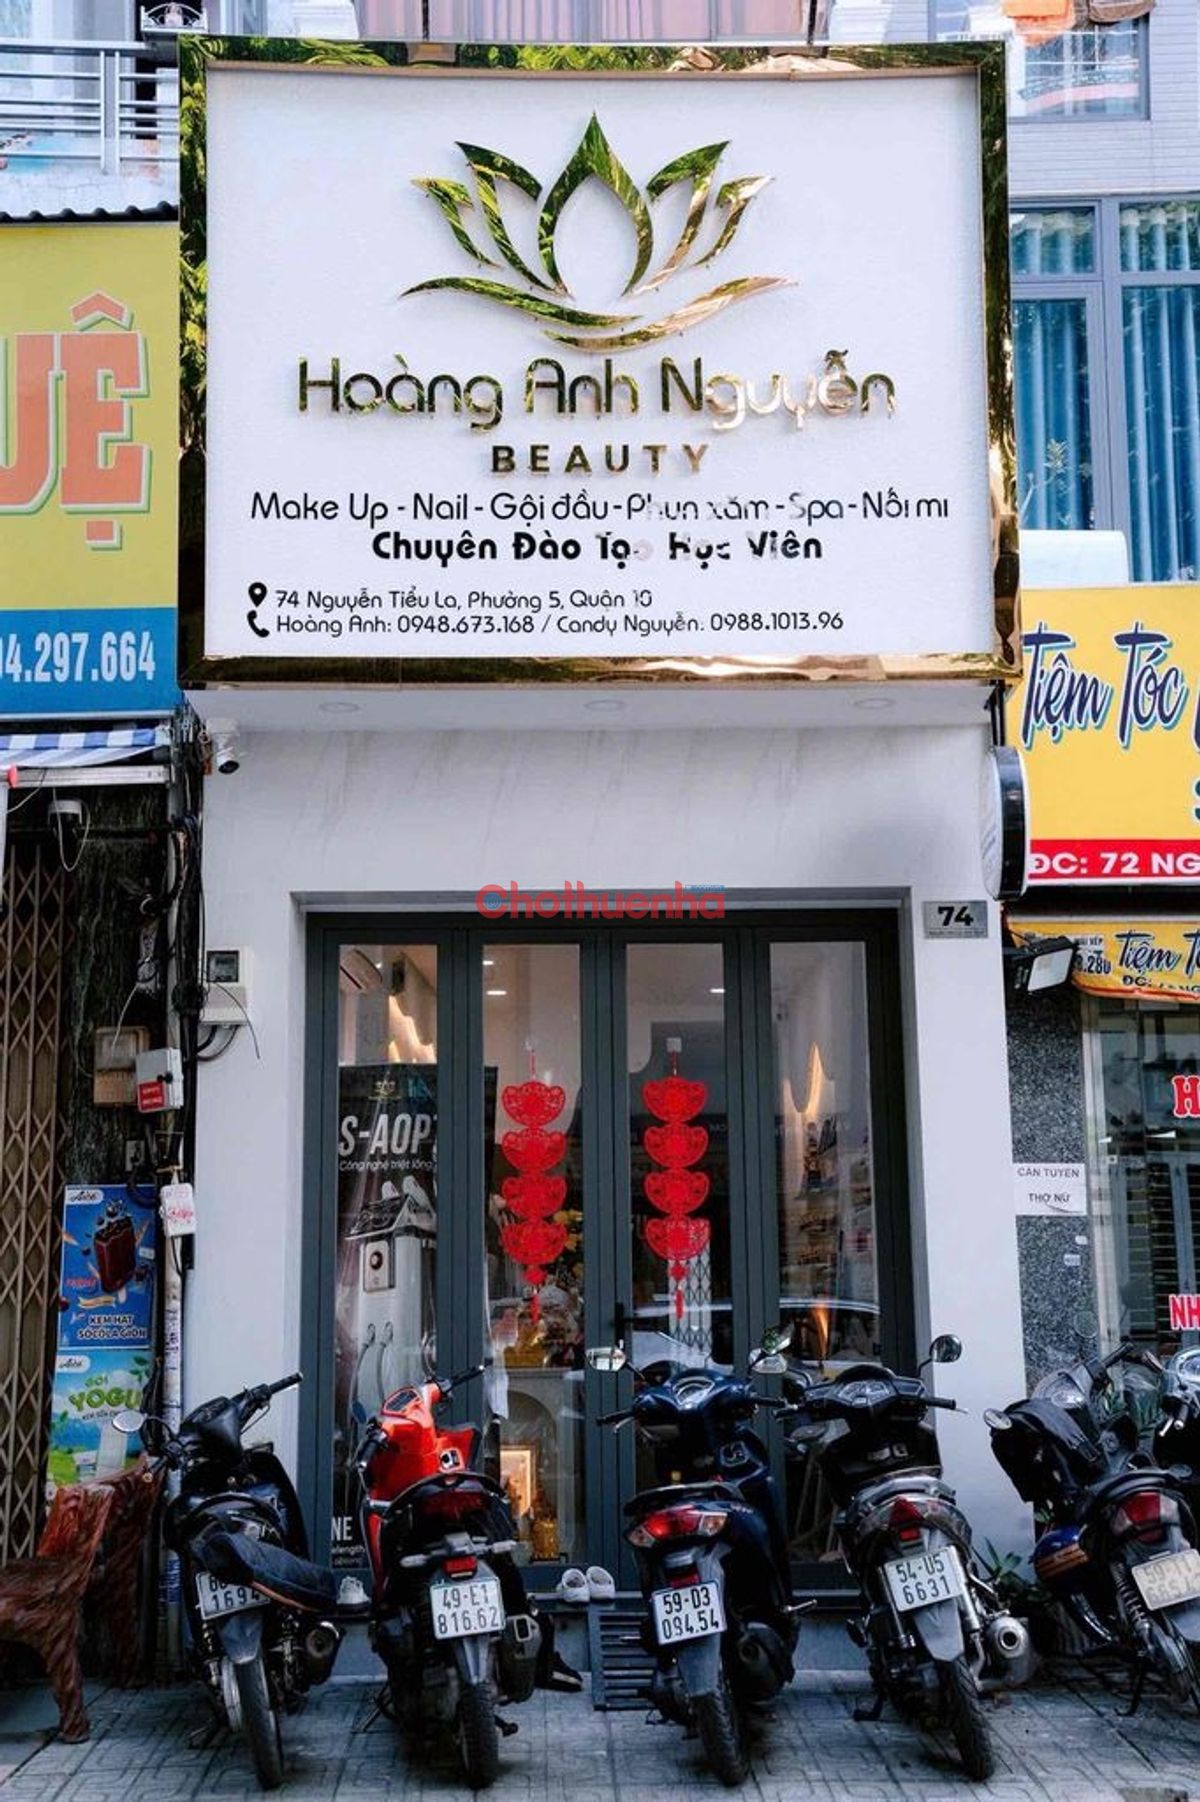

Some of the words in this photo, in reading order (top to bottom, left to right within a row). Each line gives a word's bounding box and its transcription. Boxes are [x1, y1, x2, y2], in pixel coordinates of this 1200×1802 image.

[299, 353, 503, 430] Hoàng
[525, 357, 639, 413] Anh
[661, 349, 897, 430] Nguyễn
[492, 444, 708, 473] BEAUTY
[250, 491, 339, 520] Make
[349, 493, 388, 529] Up
[413, 493, 468, 520] Nail
[490, 493, 545, 527] Gội
[551, 488, 609, 520] đầu
[626, 492, 699, 520] Phun
[706, 496, 770, 520] xăm
[788, 492, 844, 527] Spa
[372, 530, 498, 569] Chuyên
[511, 529, 582, 560] Đào
[668, 531, 731, 570] Học
[746, 529, 823, 560] Viên
[275, 589, 300, 608] 74
[306, 587, 383, 613] Nguyễn
[388, 585, 430, 609] Tiểu
[434, 590, 462, 611] La,
[467, 590, 542, 613] Phường
[548, 590, 565, 610] 5,
[570, 588, 625, 612] Quận
[632, 589, 653, 608] 10
[276, 612, 343, 637] Hoàng
[348, 614, 392, 633] Anh:
[397, 614, 535, 634] 0948.673.168
[556, 614, 617, 637] Candy
[710, 611, 844, 632] 0988.1013.96
[0, 631, 156, 684] 4.297.664
[1022, 622, 1110, 746] Tiệm
[1113, 622, 1186, 746] Tóc
[1100, 852, 1140, 875] 72
[938, 906, 974, 926] 74
[1115, 930, 1182, 974] Tiệm
[338, 1113, 437, 1157] S-AOP
[895, 1552, 945, 1583] 54-U5
[662, 1586, 711, 1615] 59-D3
[902, 1574, 951, 1605] 6631
[437, 1606, 499, 1635] 816.62
